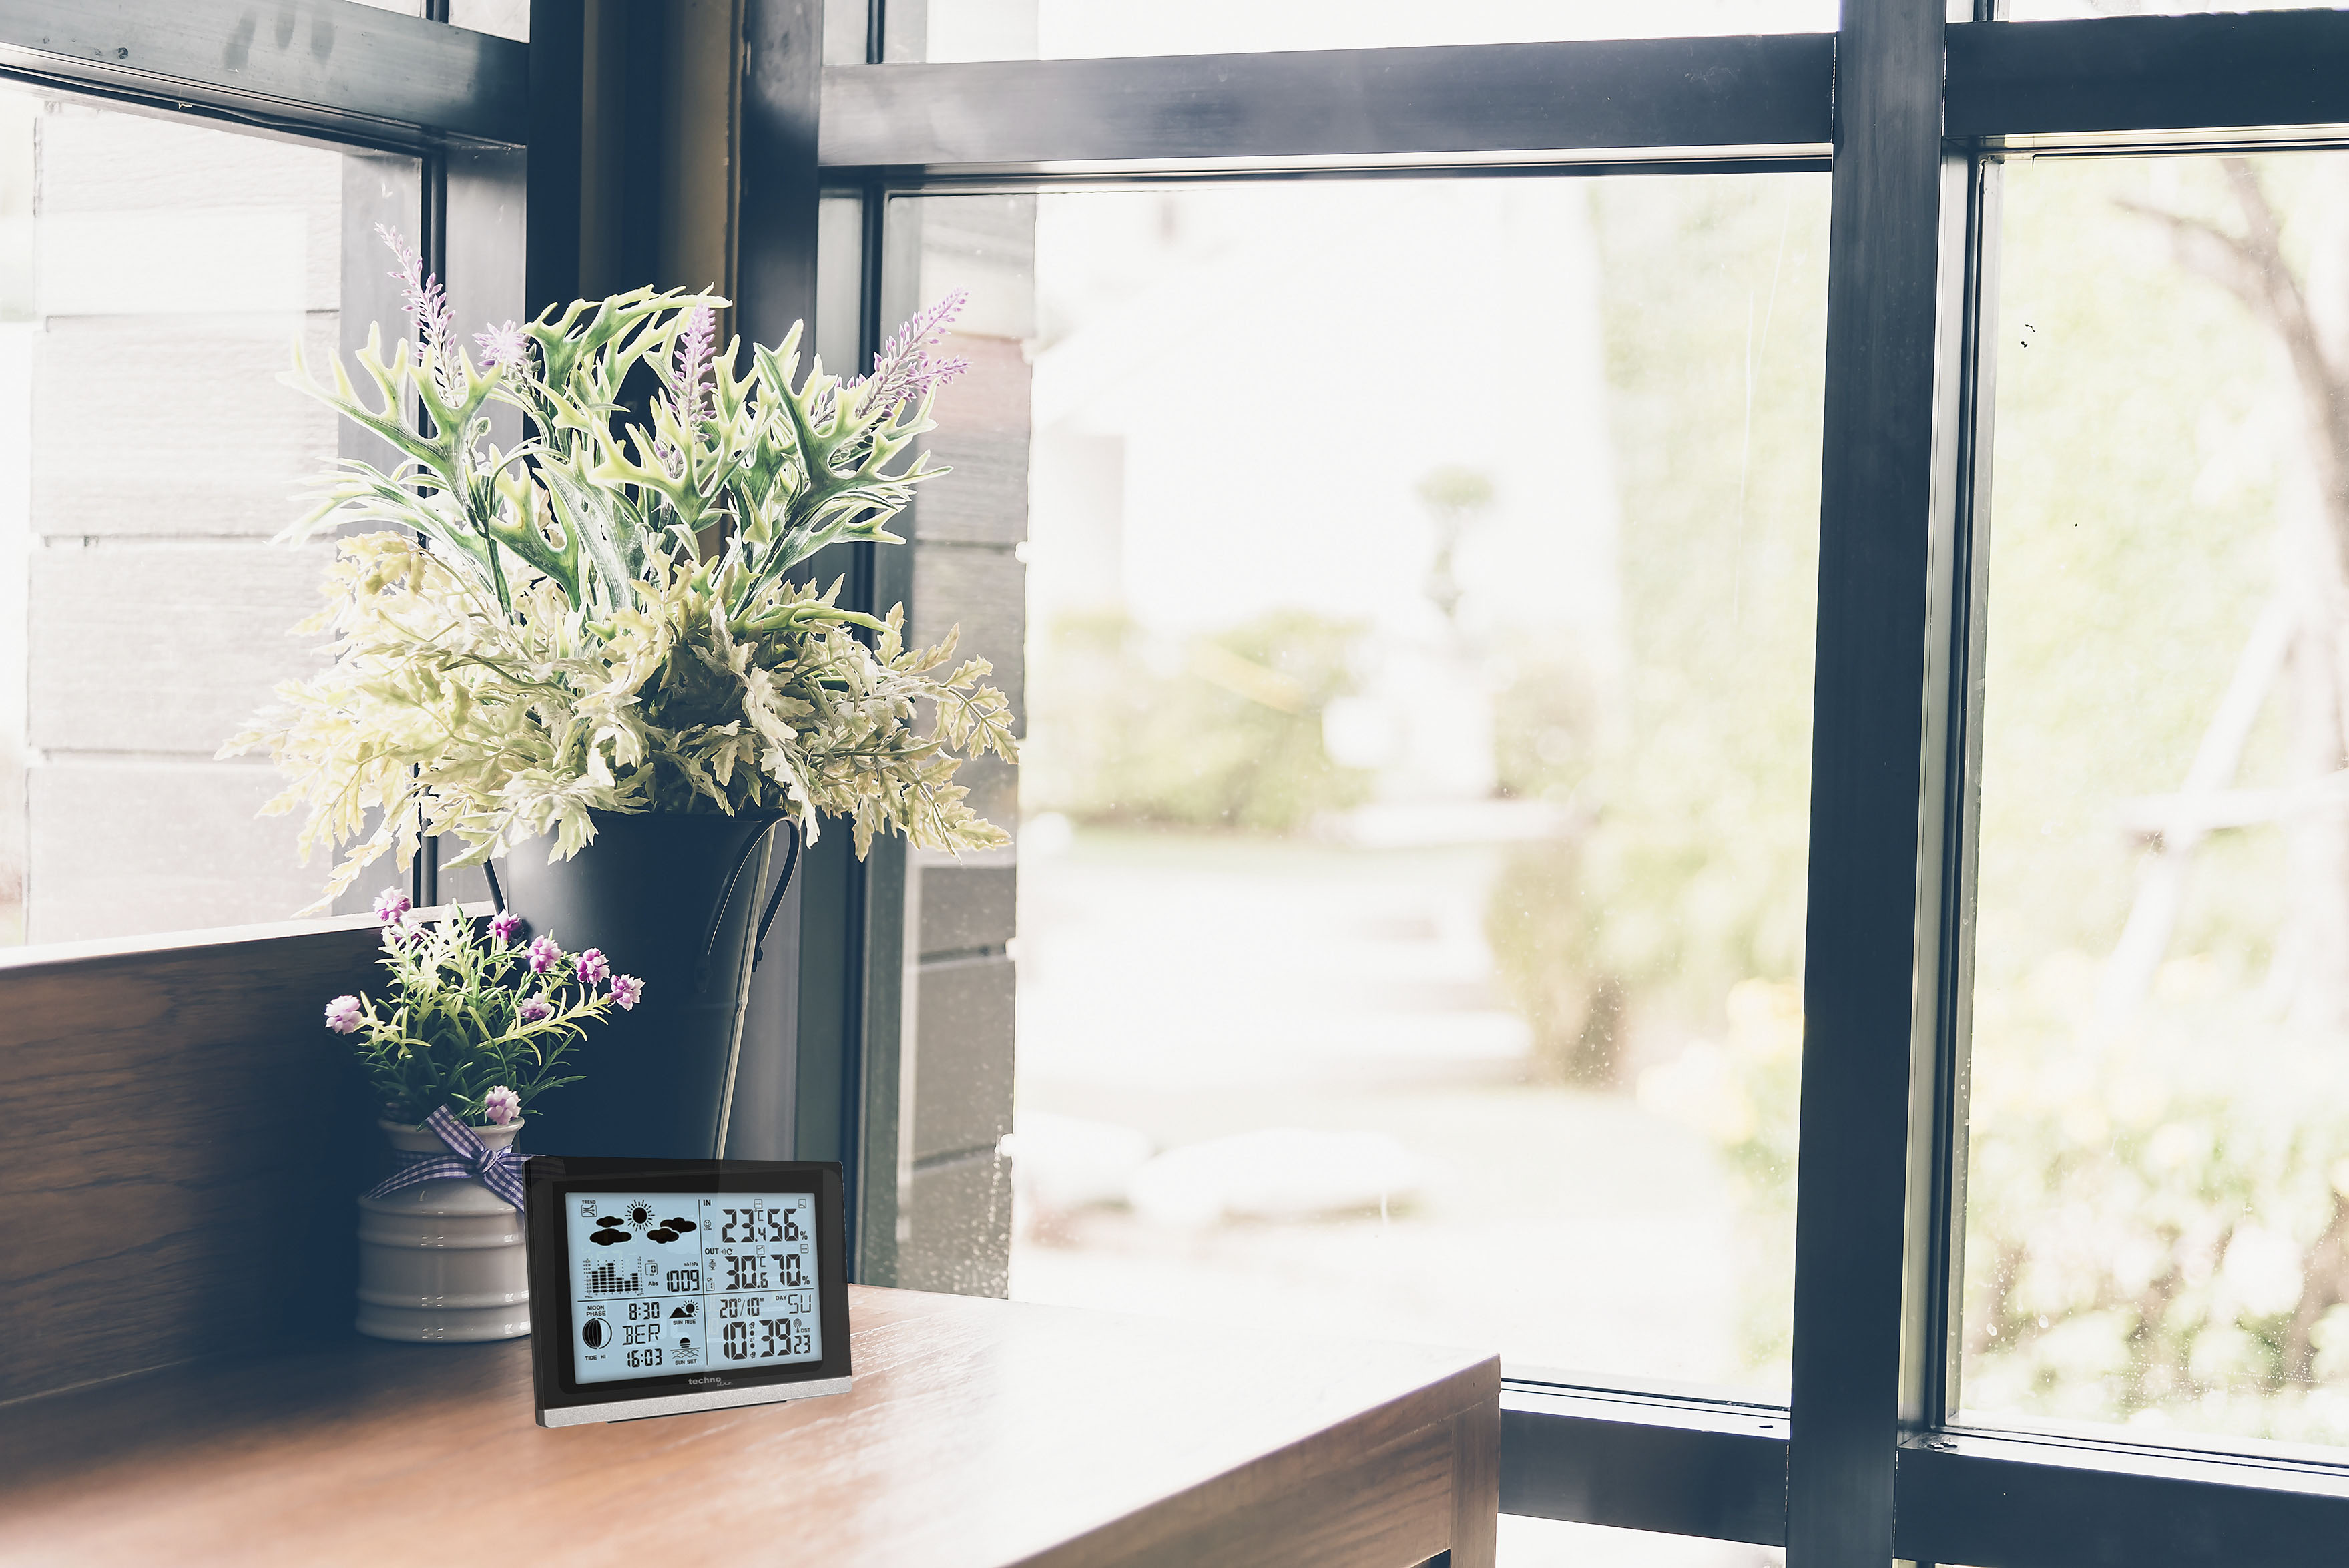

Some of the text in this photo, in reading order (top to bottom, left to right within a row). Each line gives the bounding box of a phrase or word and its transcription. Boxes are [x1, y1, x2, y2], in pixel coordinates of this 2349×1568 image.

[666, 1270, 700, 1292] 1009
[629, 1302, 660, 1320] 8:30
[788, 1294, 812, 1314] SU
[622, 1324, 660, 1346] BER
[723, 1318, 792, 1360] 10:39
[794, 1335, 811, 1354] 23
[627, 1348, 662, 1367] 16:03
[688, 1377, 721, 1385] techno
